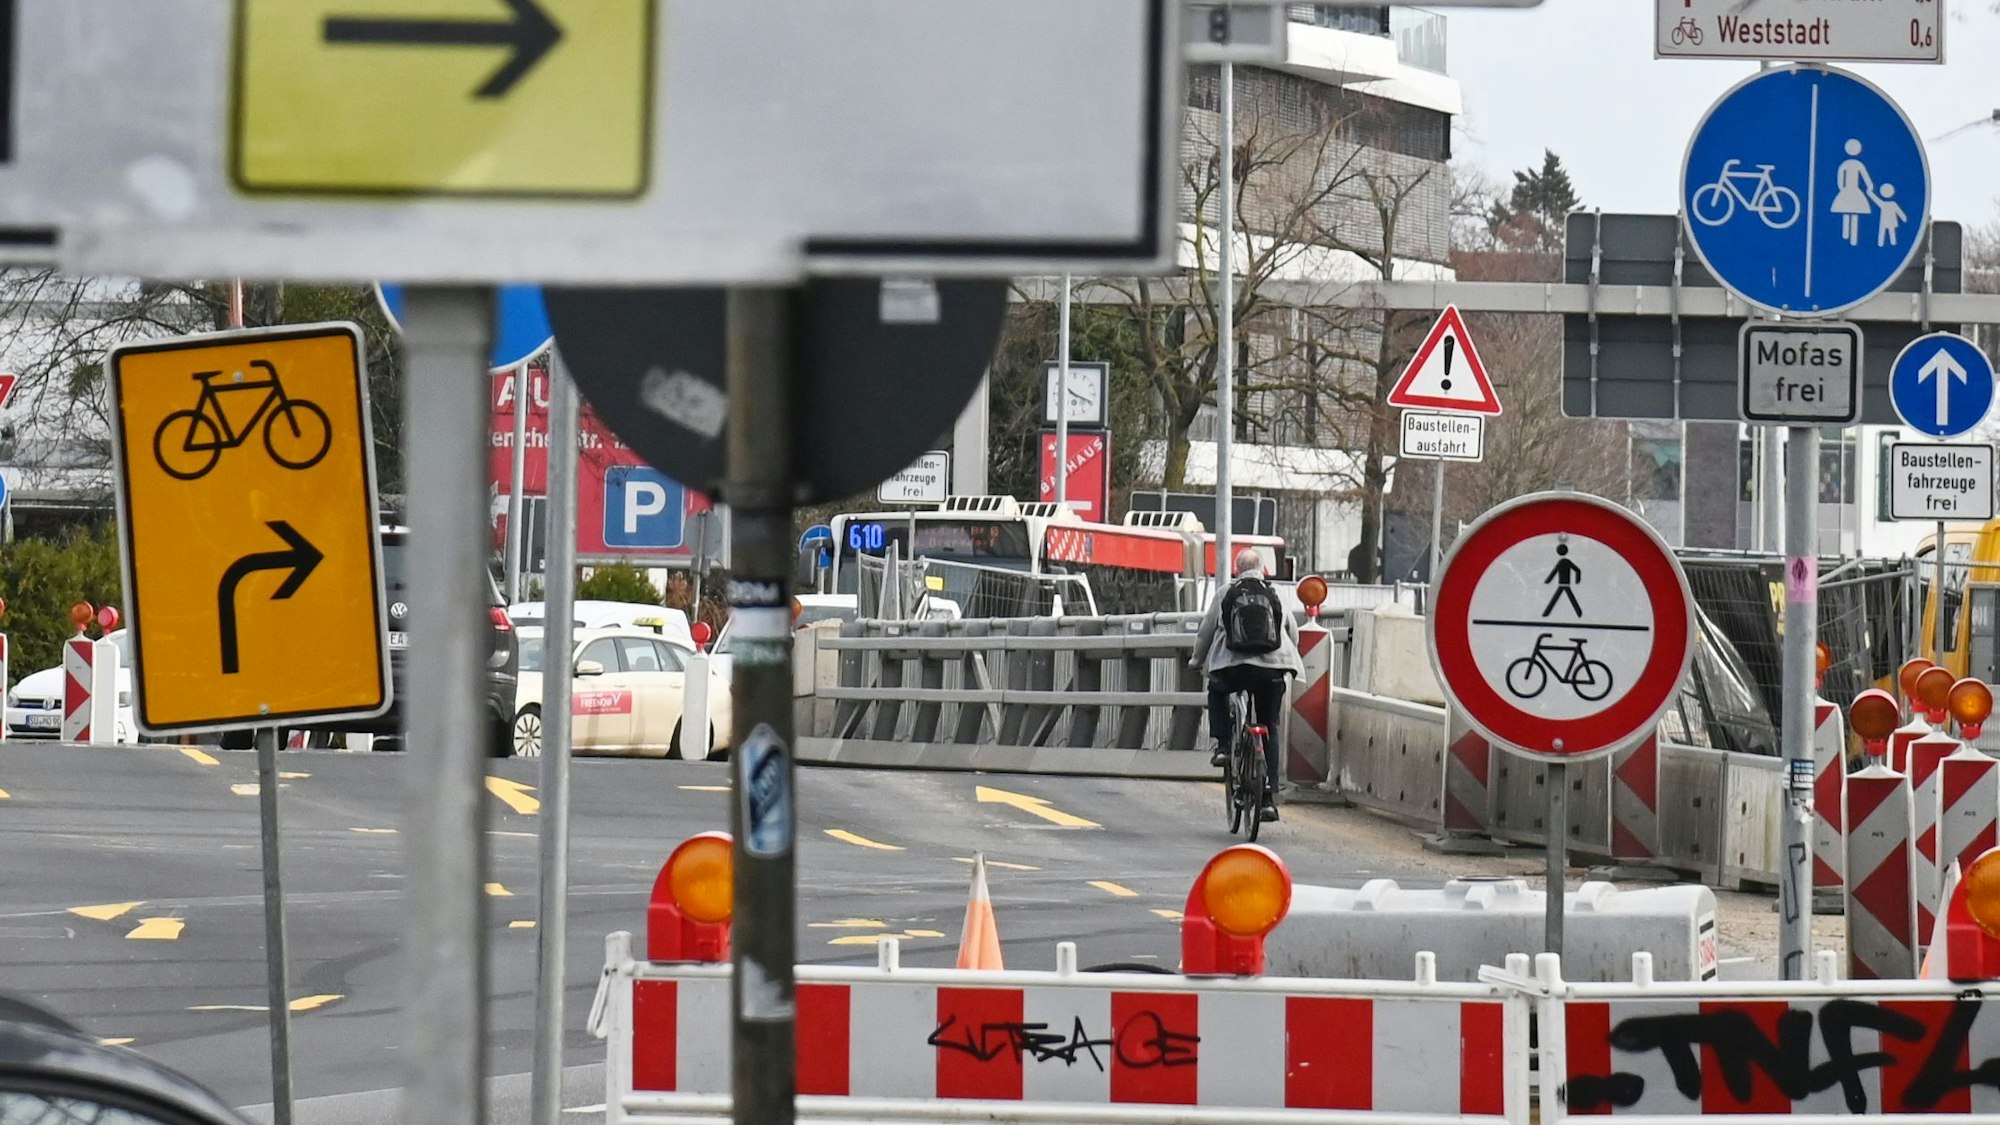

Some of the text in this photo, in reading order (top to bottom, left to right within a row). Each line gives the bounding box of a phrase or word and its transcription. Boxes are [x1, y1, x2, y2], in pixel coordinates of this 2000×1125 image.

[1717, 15, 1932, 47] Weststadt 0,6
[1757, 340, 1843, 366] Mofas
[1776, 377, 1824, 402] frei
[1408, 416, 1477, 434] Baustellen-
[1416, 439, 1466, 453] ausfahrt
[1041, 437, 1104, 494] BAHAUS
[1901, 451, 1982, 468] Baustellen-
[903, 486, 924, 497] frei
[1907, 472, 1976, 493] fahrzeuge
[625, 481, 667, 534] P
[1926, 494, 1957, 511] frei
[849, 523, 883, 549] 610
